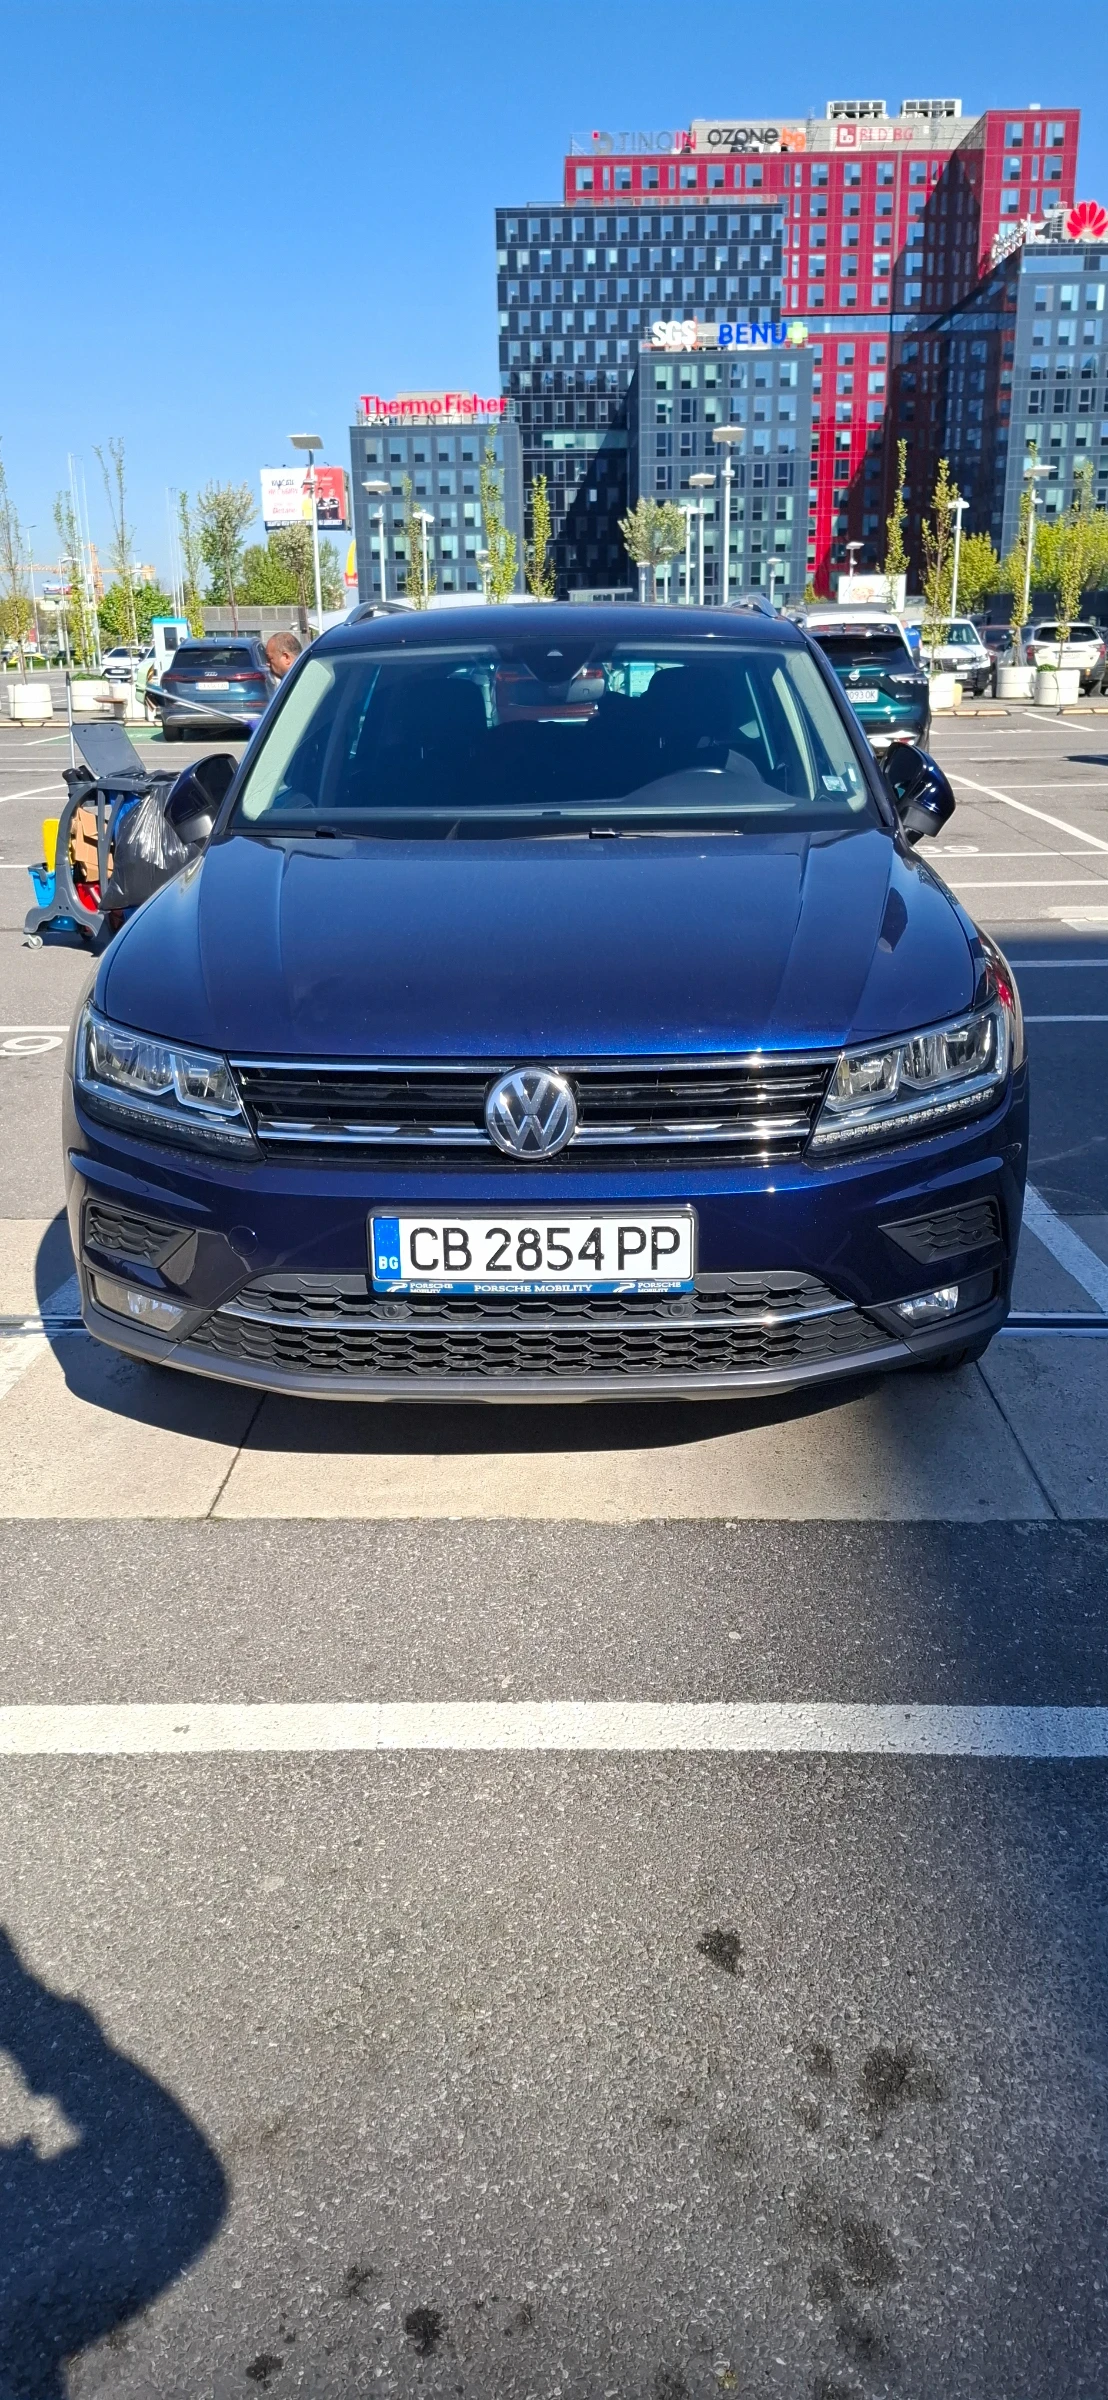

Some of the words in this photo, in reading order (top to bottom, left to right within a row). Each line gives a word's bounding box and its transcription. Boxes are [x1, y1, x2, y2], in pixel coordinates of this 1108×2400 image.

[651, 320, 697, 346] SGS
[718, 322, 787, 345] BENU
[409, 1227, 472, 1271] CB
[485, 1227, 605, 1271] 2854
[617, 1226, 681, 1271] PP
[378, 1256, 398, 1270] BG
[474, 1284, 532, 1293] PORSCHE
[535, 1284, 593, 1292] MOBILITY
